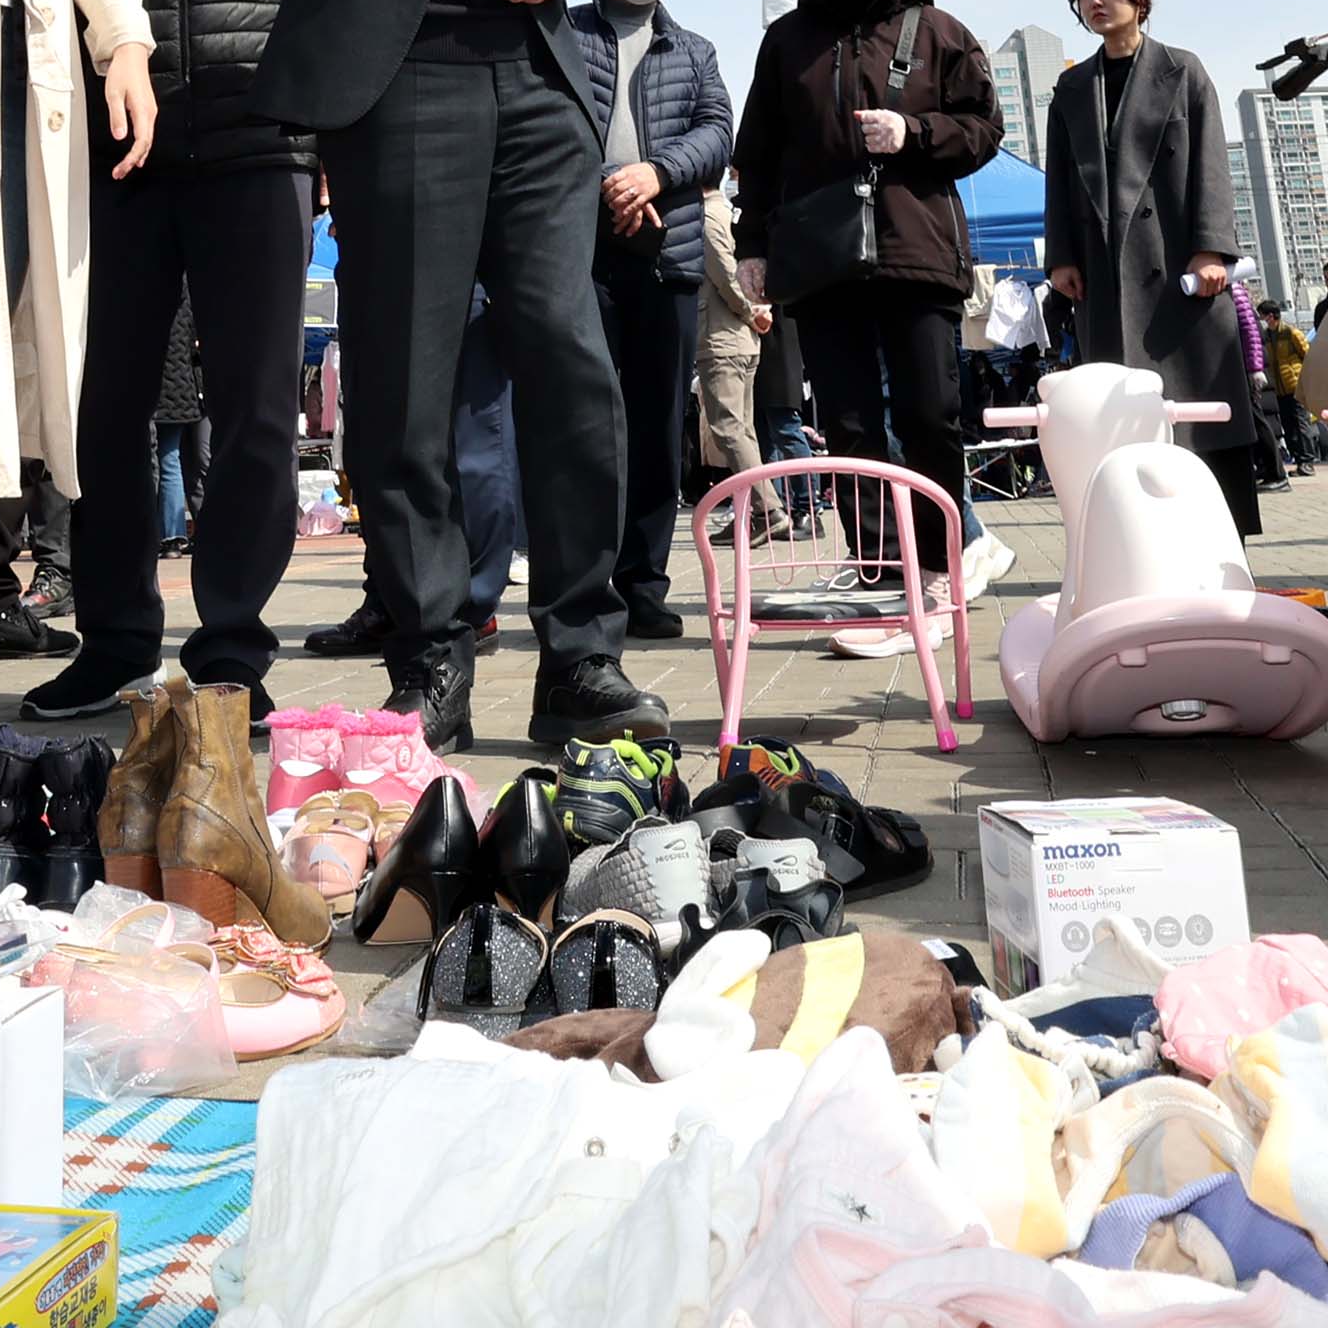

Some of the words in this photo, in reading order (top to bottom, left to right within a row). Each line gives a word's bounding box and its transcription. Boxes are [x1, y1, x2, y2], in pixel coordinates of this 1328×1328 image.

[1042, 842, 1122, 860] maxon
[1045, 860, 1096, 871] MXBT-1000
[1046, 874, 1065, 884] LED
[1048, 885, 1094, 898] Bluetooth
[1098, 884, 1136, 896] Speaker
[1049, 901, 1078, 912] Mood
